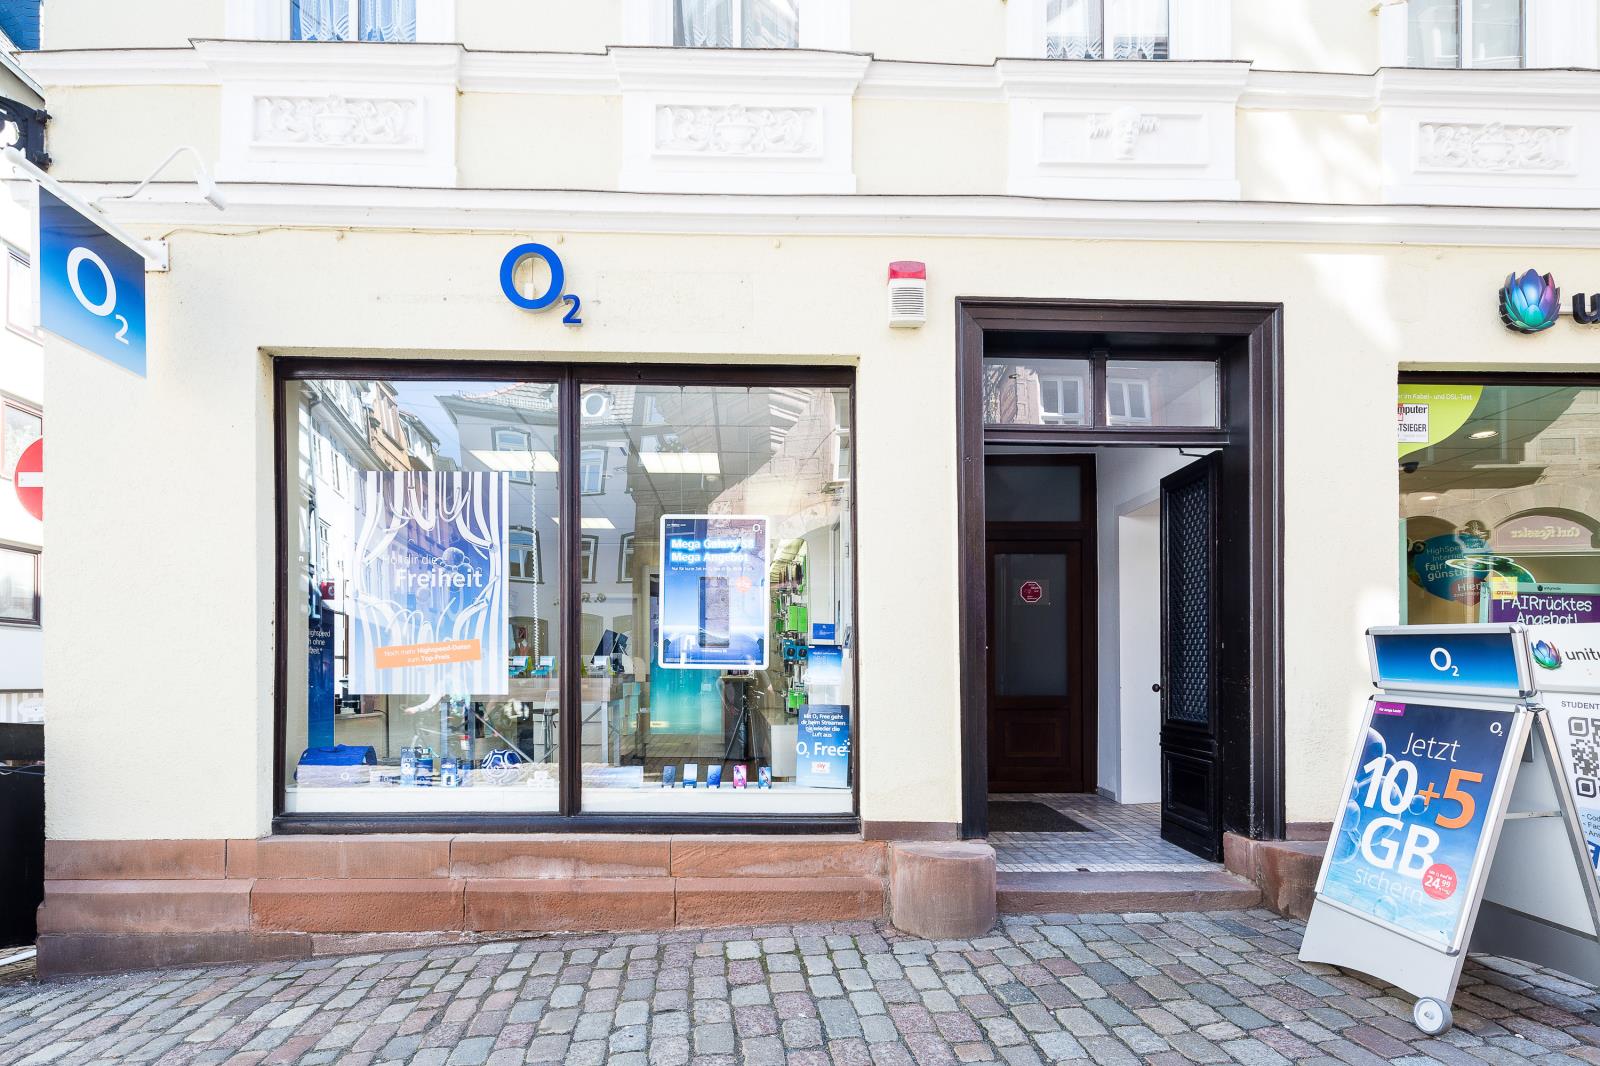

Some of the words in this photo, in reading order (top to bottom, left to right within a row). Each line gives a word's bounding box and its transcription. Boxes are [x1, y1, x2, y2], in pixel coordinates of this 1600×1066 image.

[499, 242, 582, 326] O2
[1398, 423, 1427, 433] TSIEGER
[671, 540, 701, 550] Mega
[421, 553, 438, 564] die
[671, 552, 701, 564] Mega
[703, 552, 748, 563] Angebot
[397, 567, 483, 588] Freiheit
[1501, 595, 1593, 612] FAIRrücktes
[1429, 647, 1460, 677] O2
[1489, 721, 1504, 737] O2
[796, 741, 811, 759] O2
[814, 741, 846, 757] Free
[1401, 731, 1461, 763] Jetzt
[1361, 816, 1440, 880] GB
[1353, 867, 1425, 906] sichern
